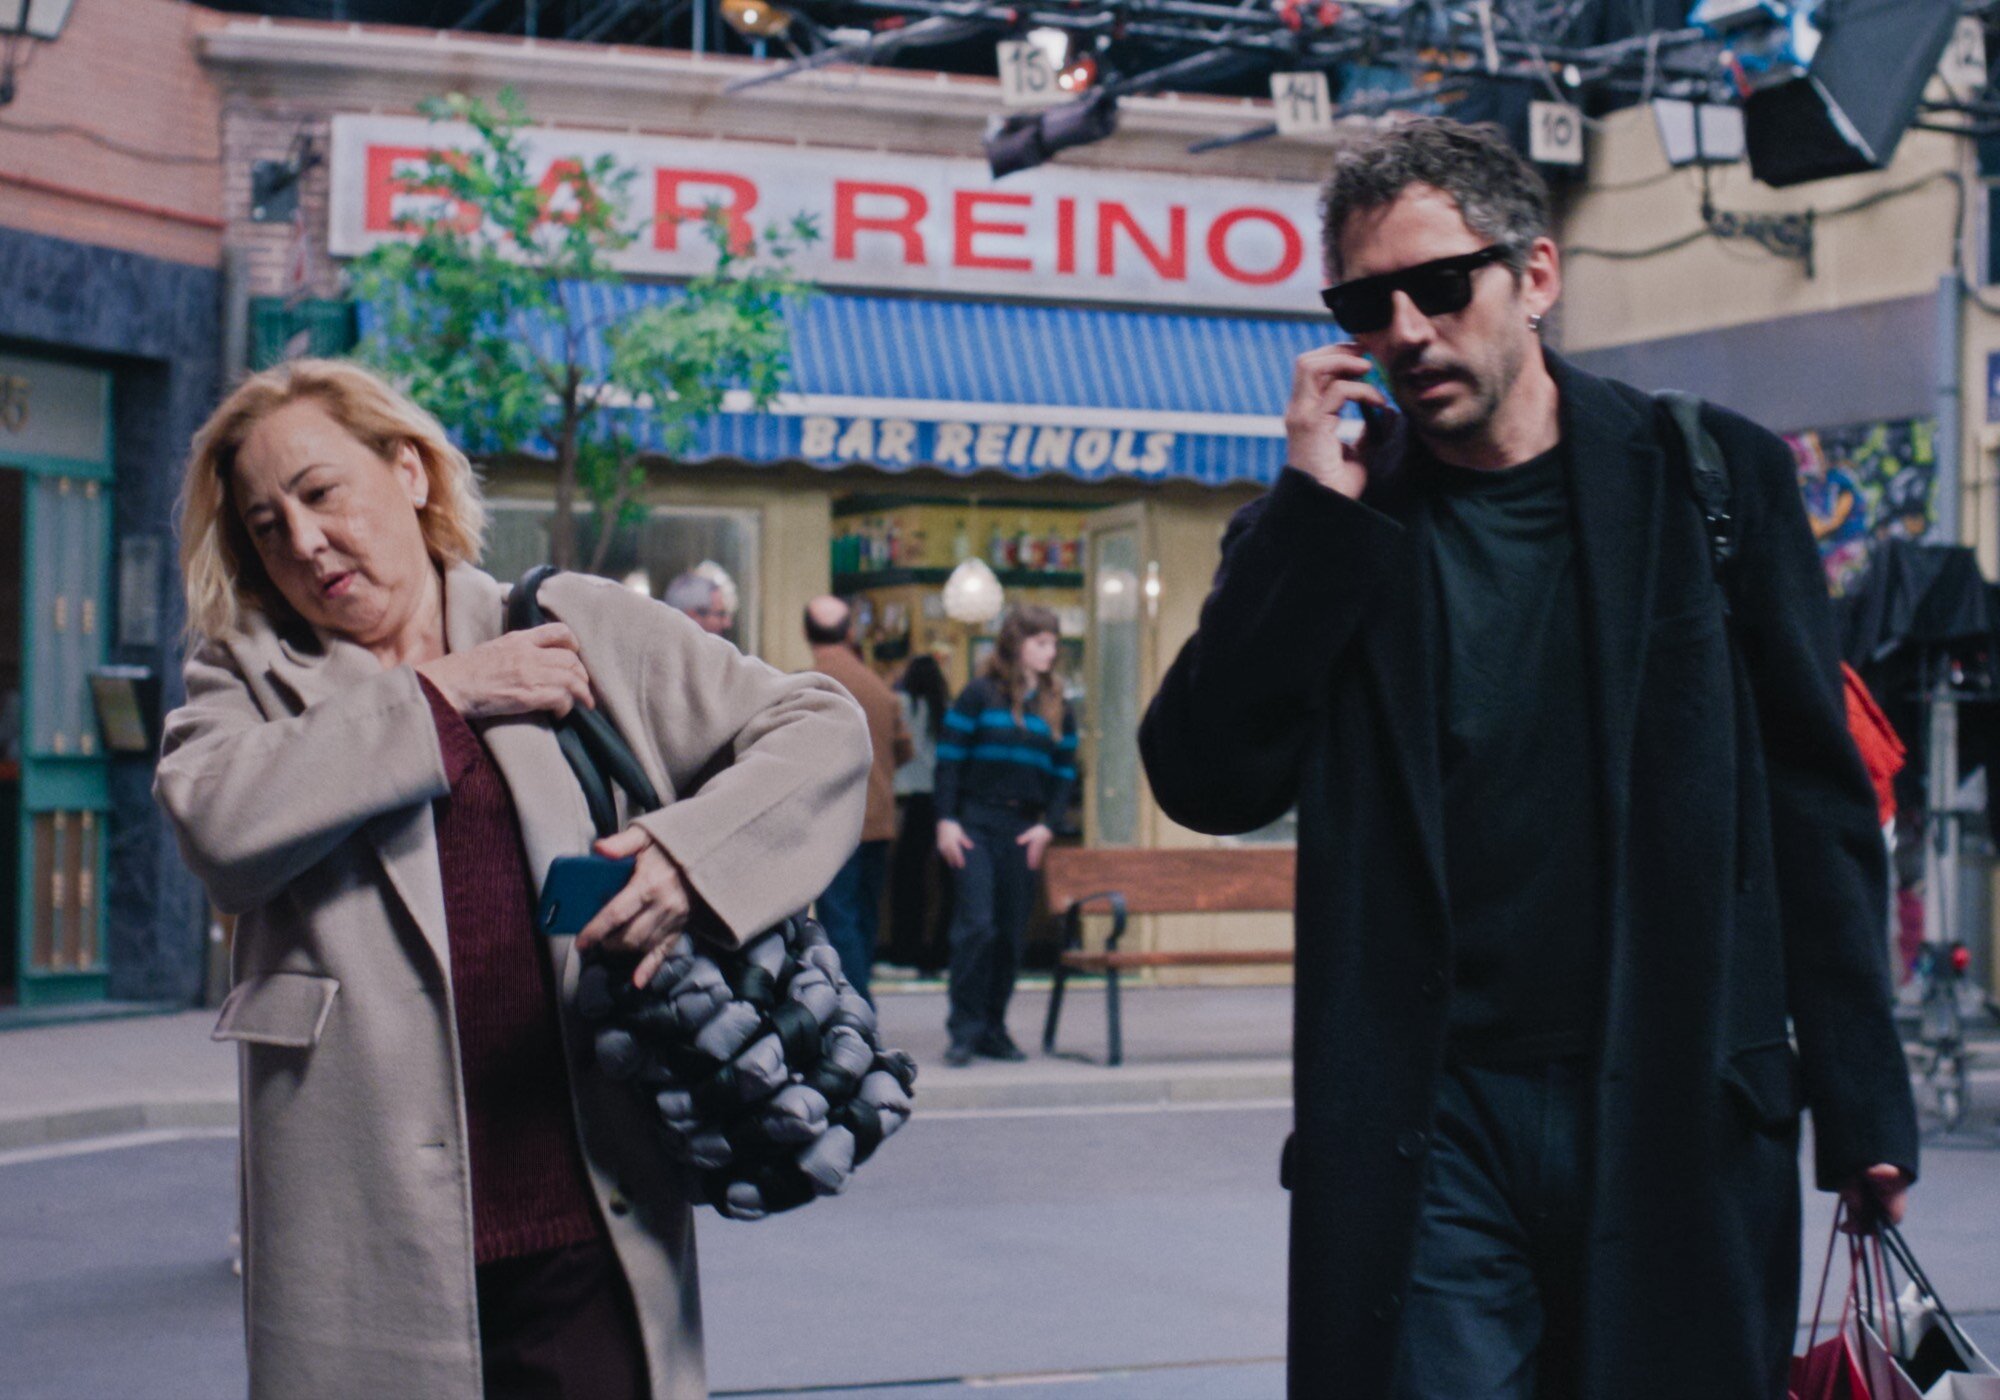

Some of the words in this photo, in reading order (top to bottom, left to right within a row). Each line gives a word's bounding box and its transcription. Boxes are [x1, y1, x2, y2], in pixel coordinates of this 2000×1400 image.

[1008, 47, 1048, 93] 15
[1282, 79, 1319, 122] 14
[1542, 112, 1571, 147] 10
[365, 143, 758, 257] BAR
[833, 180, 1331, 287] REINO
[801, 416, 917, 465] BAR
[934, 421, 1175, 474] REINOLS
